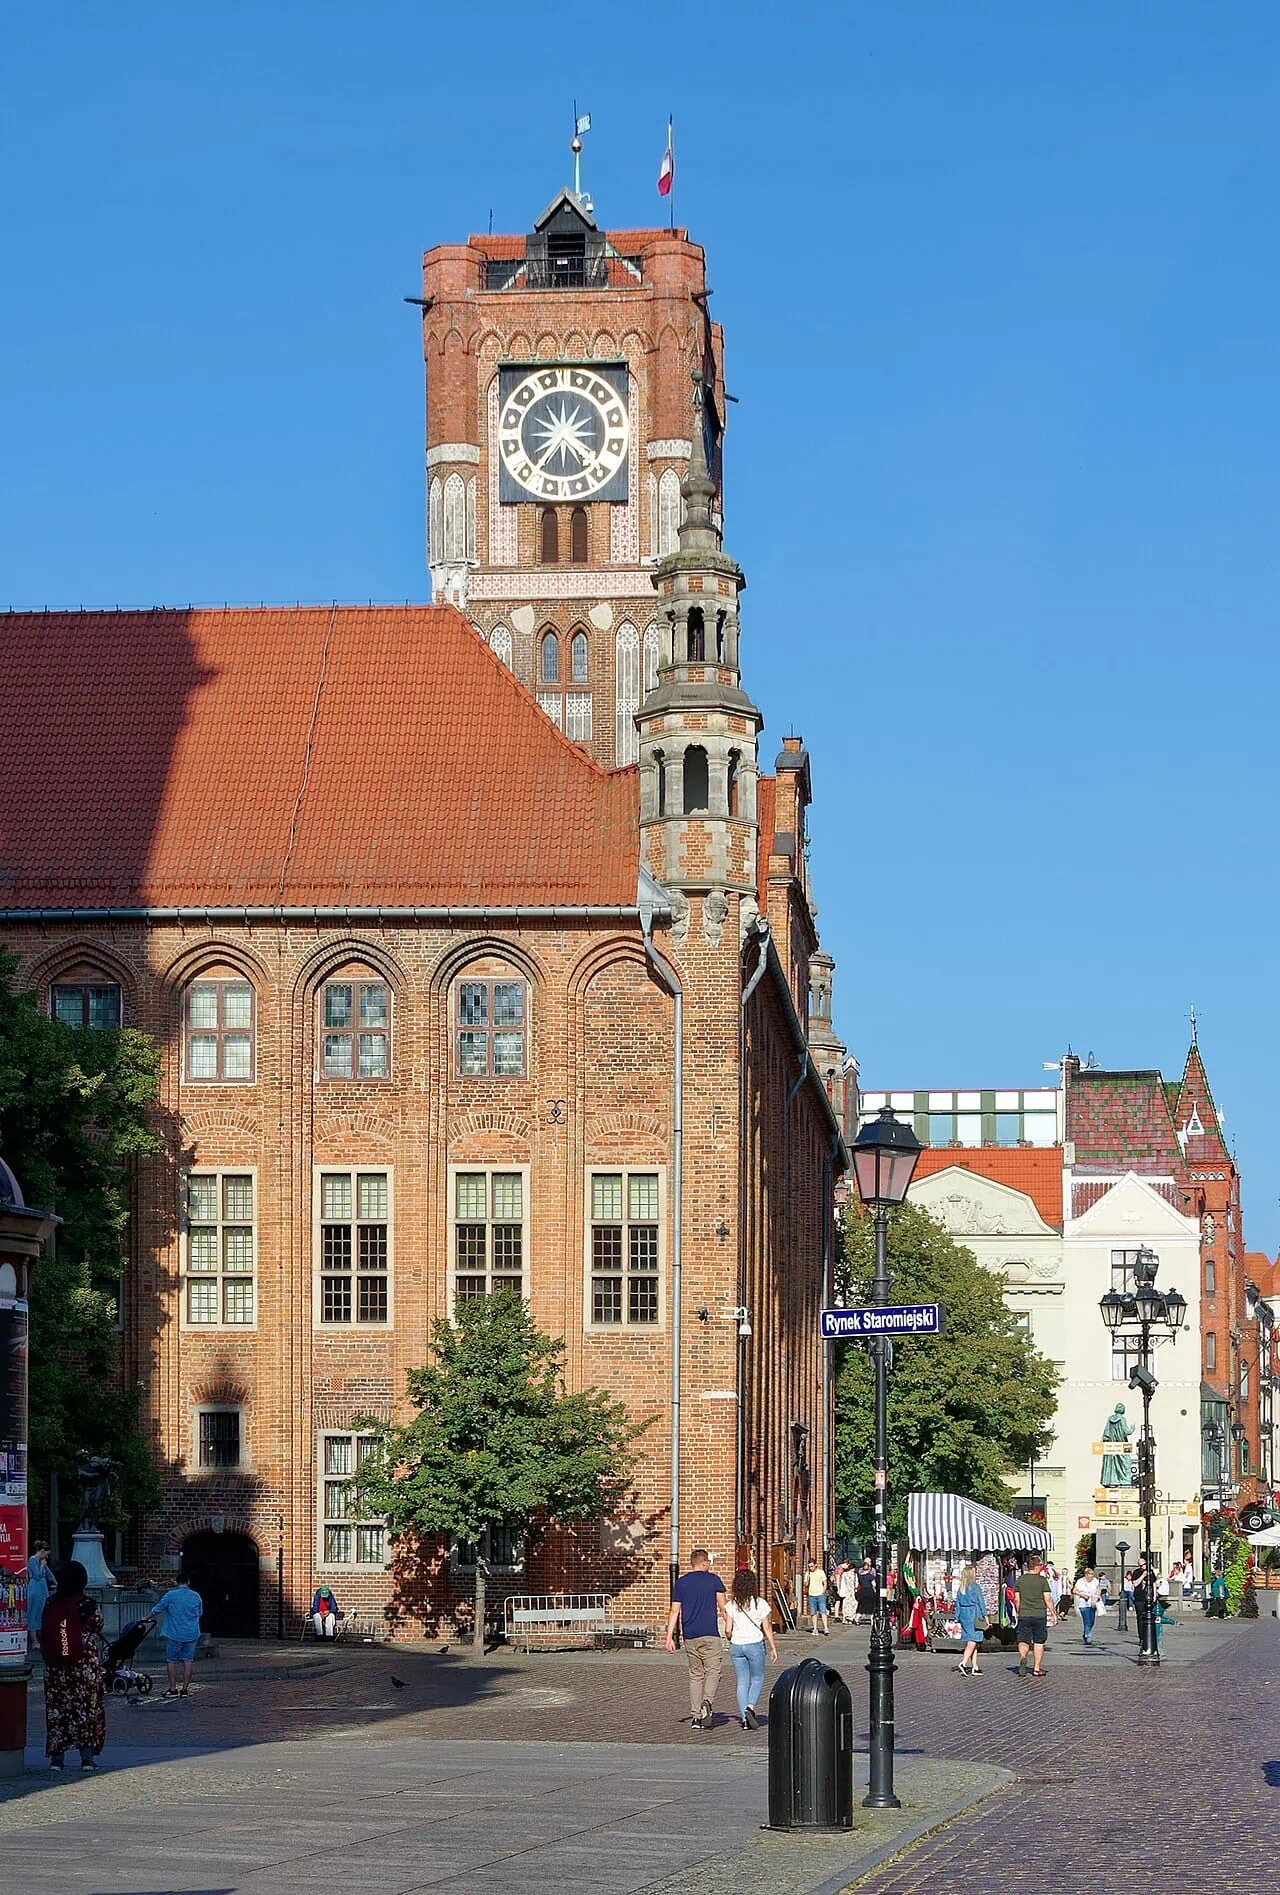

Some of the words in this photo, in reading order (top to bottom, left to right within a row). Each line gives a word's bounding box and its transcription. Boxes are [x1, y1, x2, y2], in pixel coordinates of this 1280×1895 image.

[826, 1313, 861, 1334] Rynek
[863, 1309, 933, 1330] Staromiejski
[60, 1628, 69, 1656] Reebok
